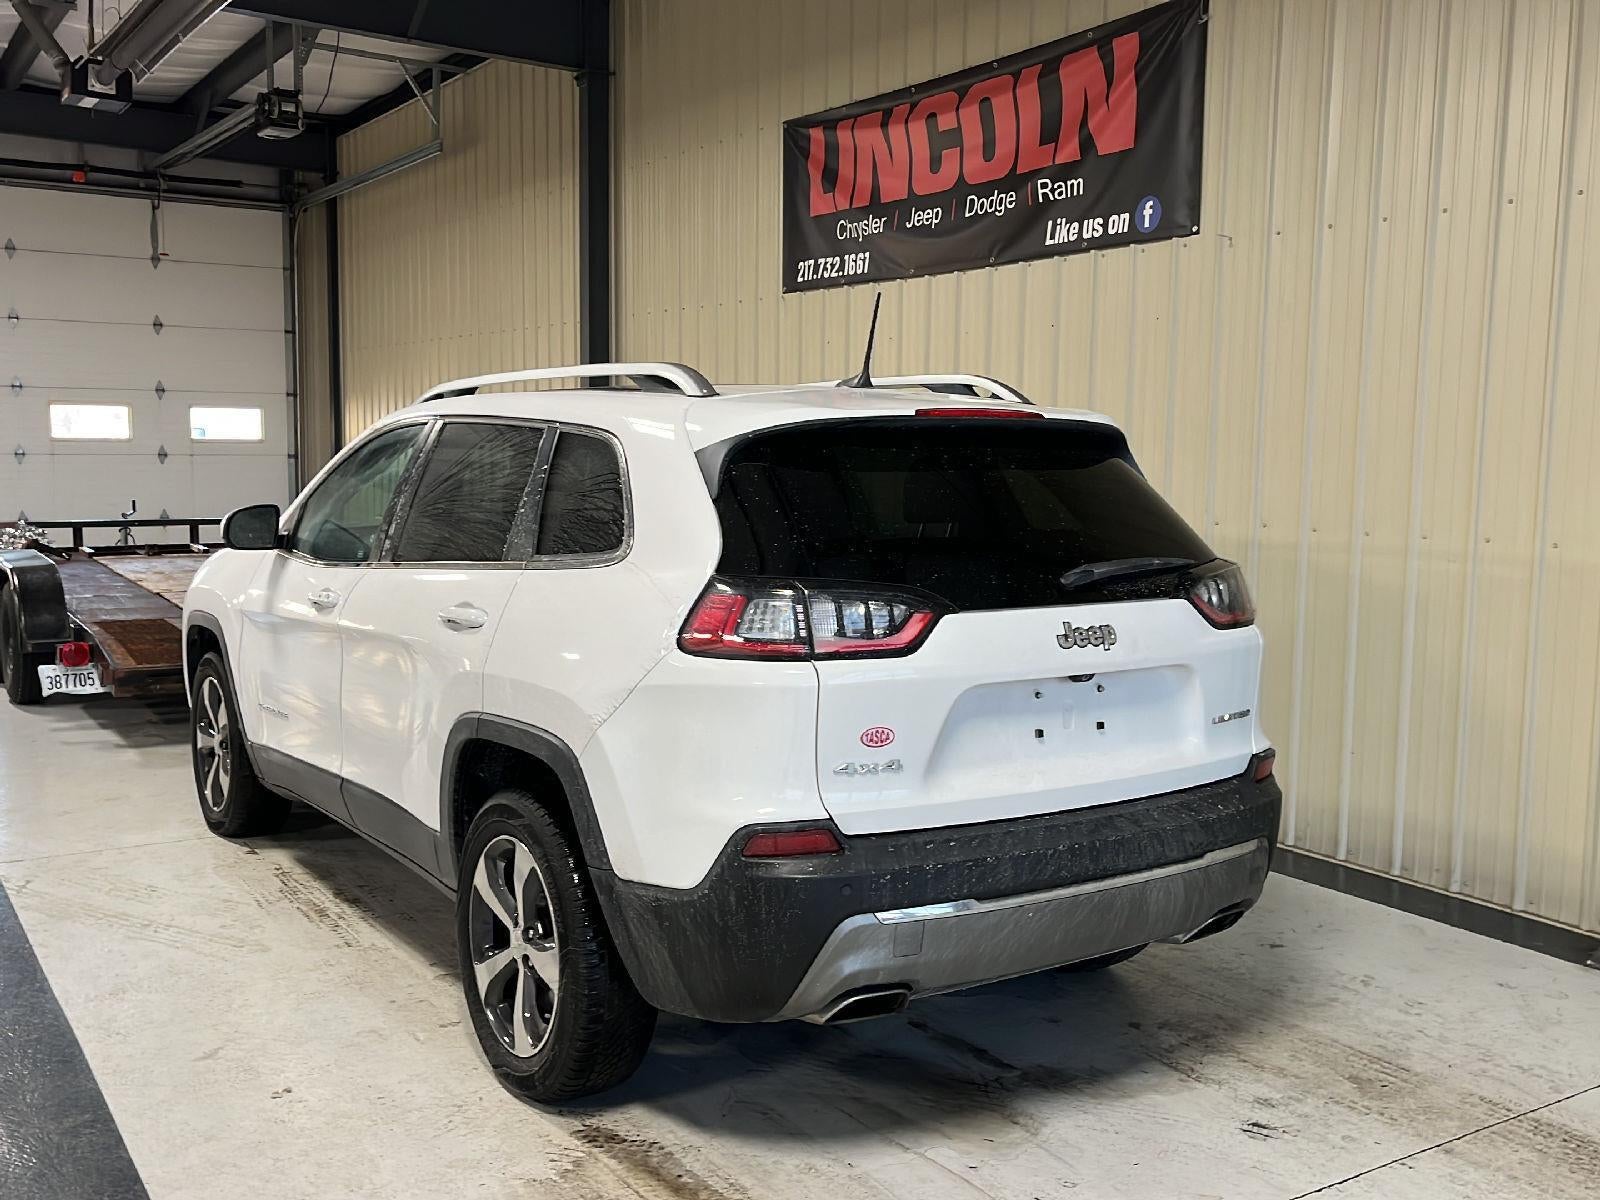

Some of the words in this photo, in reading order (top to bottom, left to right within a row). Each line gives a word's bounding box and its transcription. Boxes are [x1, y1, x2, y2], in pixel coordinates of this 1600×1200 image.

[807, 31, 1140, 217] LINCOLN
[836, 214, 887, 242] Chrysler
[905, 206, 942, 229] Jeep
[964, 189, 1016, 218] Dodge
[1037, 177, 1084, 203] Ram
[1044, 217, 1078, 246] Like
[1082, 216, 1104, 240] us
[1107, 211, 1130, 235] on
[1056, 621, 1117, 651] Jeep
[46, 671, 95, 691] 387705
[864, 729, 891, 745] TASCA
[833, 759, 903, 777] 4x4
